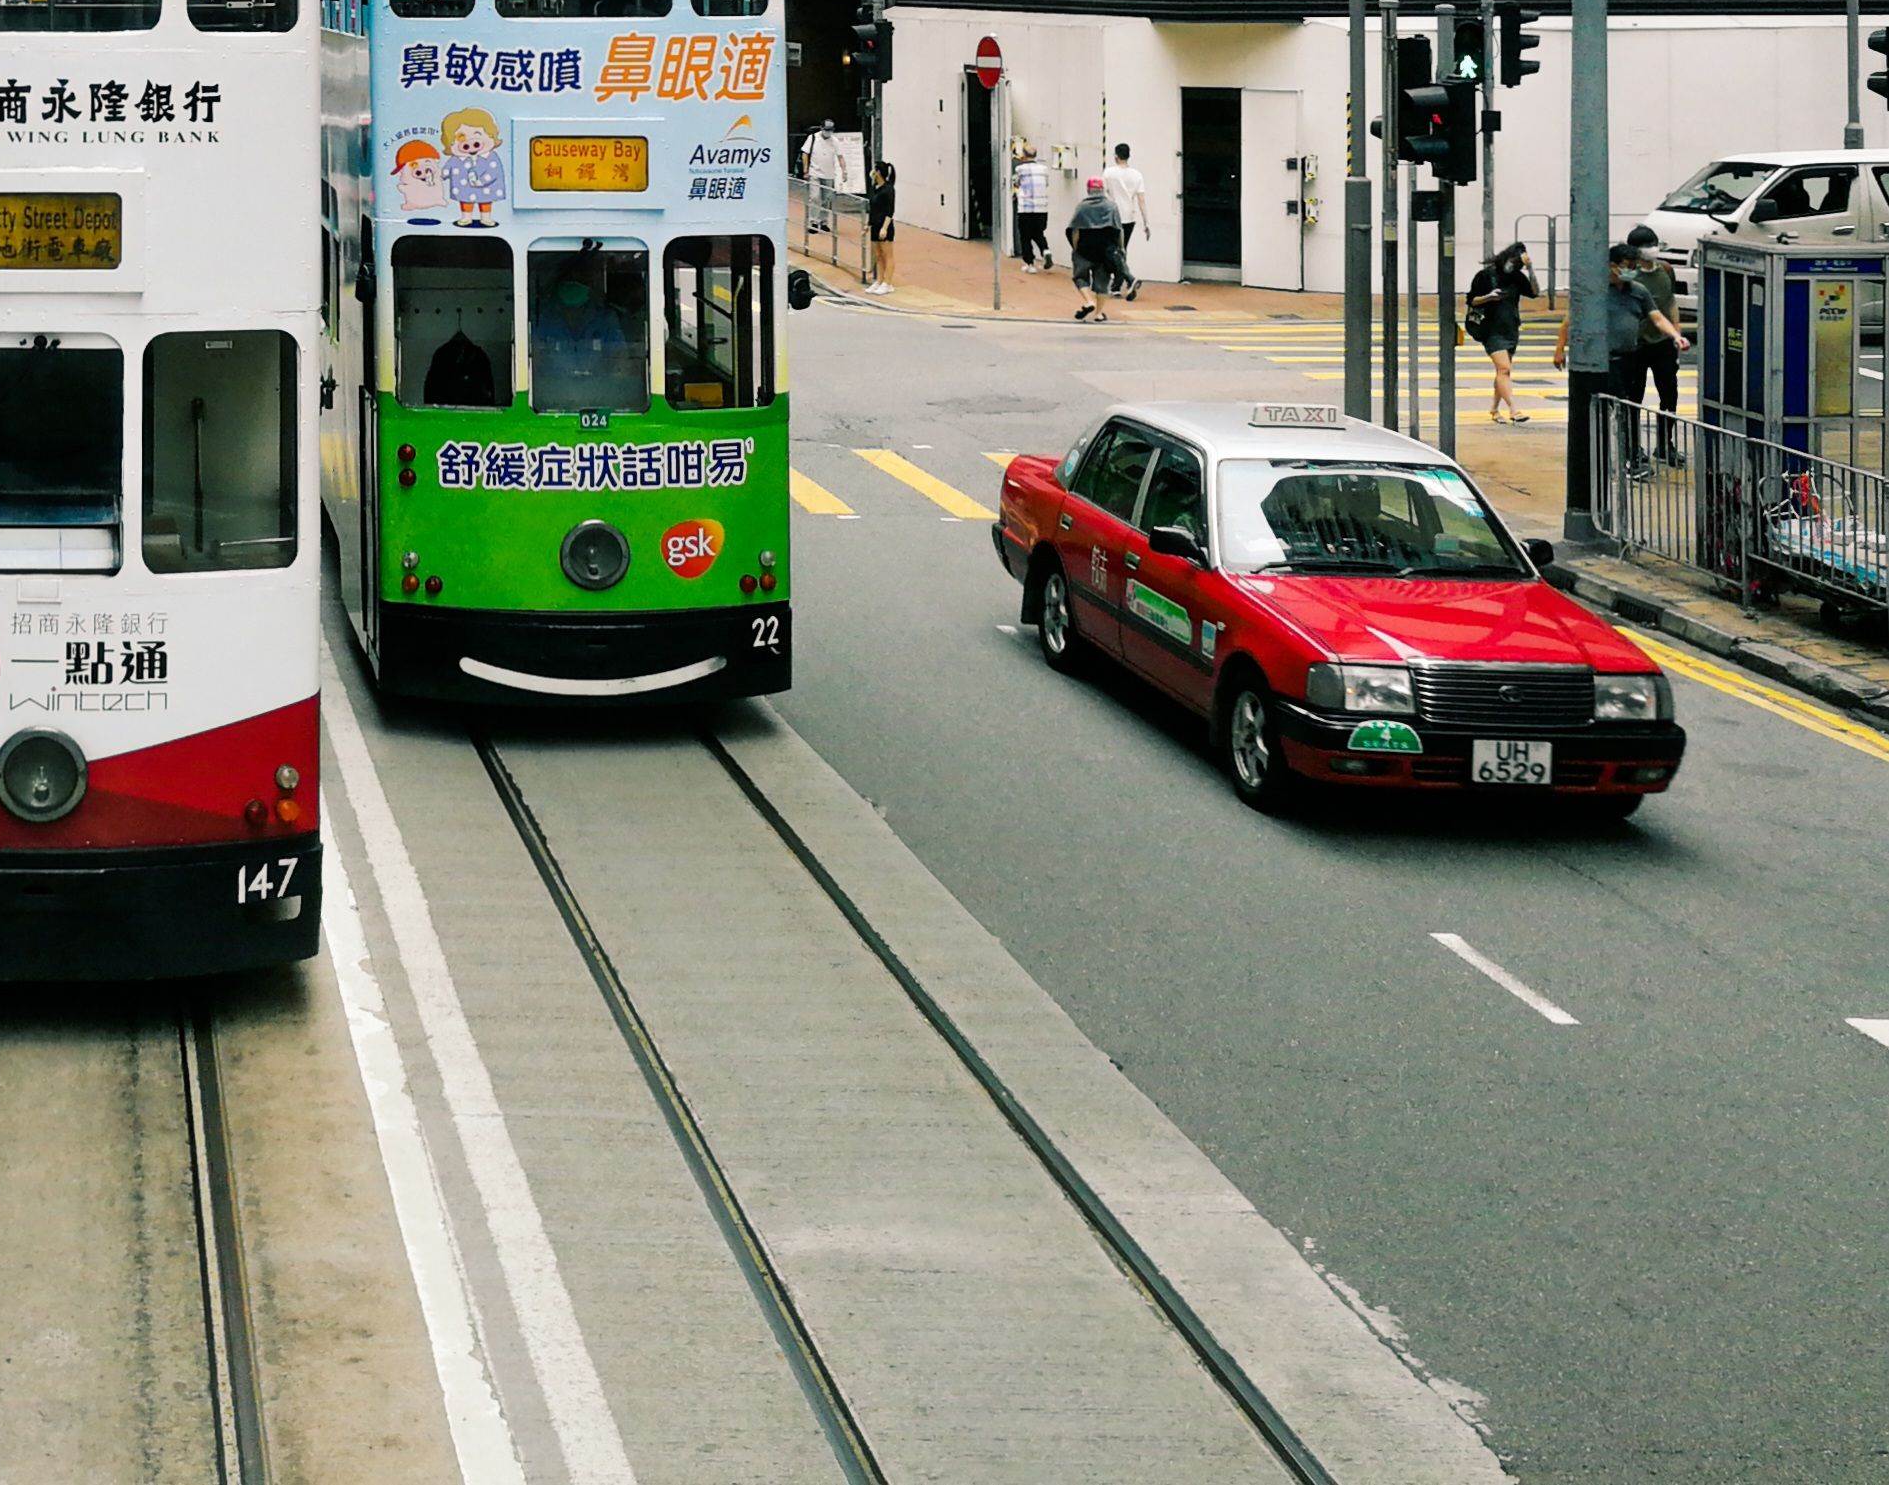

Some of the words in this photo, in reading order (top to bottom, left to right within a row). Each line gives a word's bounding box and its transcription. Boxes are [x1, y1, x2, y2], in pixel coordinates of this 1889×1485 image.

[400, 44, 582, 93] 鼻敏感噴
[594, 32, 776, 103] 鼻眼適
[7, 130, 68, 144] WING
[82, 130, 145, 144] LUNG
[158, 130, 220, 144] BANK
[532, 139, 607, 161] Causeway
[614, 140, 641, 162] Bay
[689, 144, 771, 168] Avamys
[543, 163, 630, 182] 銅鑼灣
[688, 176, 748, 200] 鼻眼適
[23, 206, 68, 230] Street
[581, 413, 608, 428] 024
[1264, 406, 1337, 423] TAXI
[667, 528, 716, 566] gsk
[10, 612, 168, 636] 招商永隆銀行
[751, 615, 780, 648] 22
[10, 641, 169, 686] 一點通
[1496, 741, 1529, 762] UH
[1478, 762, 1546, 783] 6529
[237, 858, 299, 905] 147
